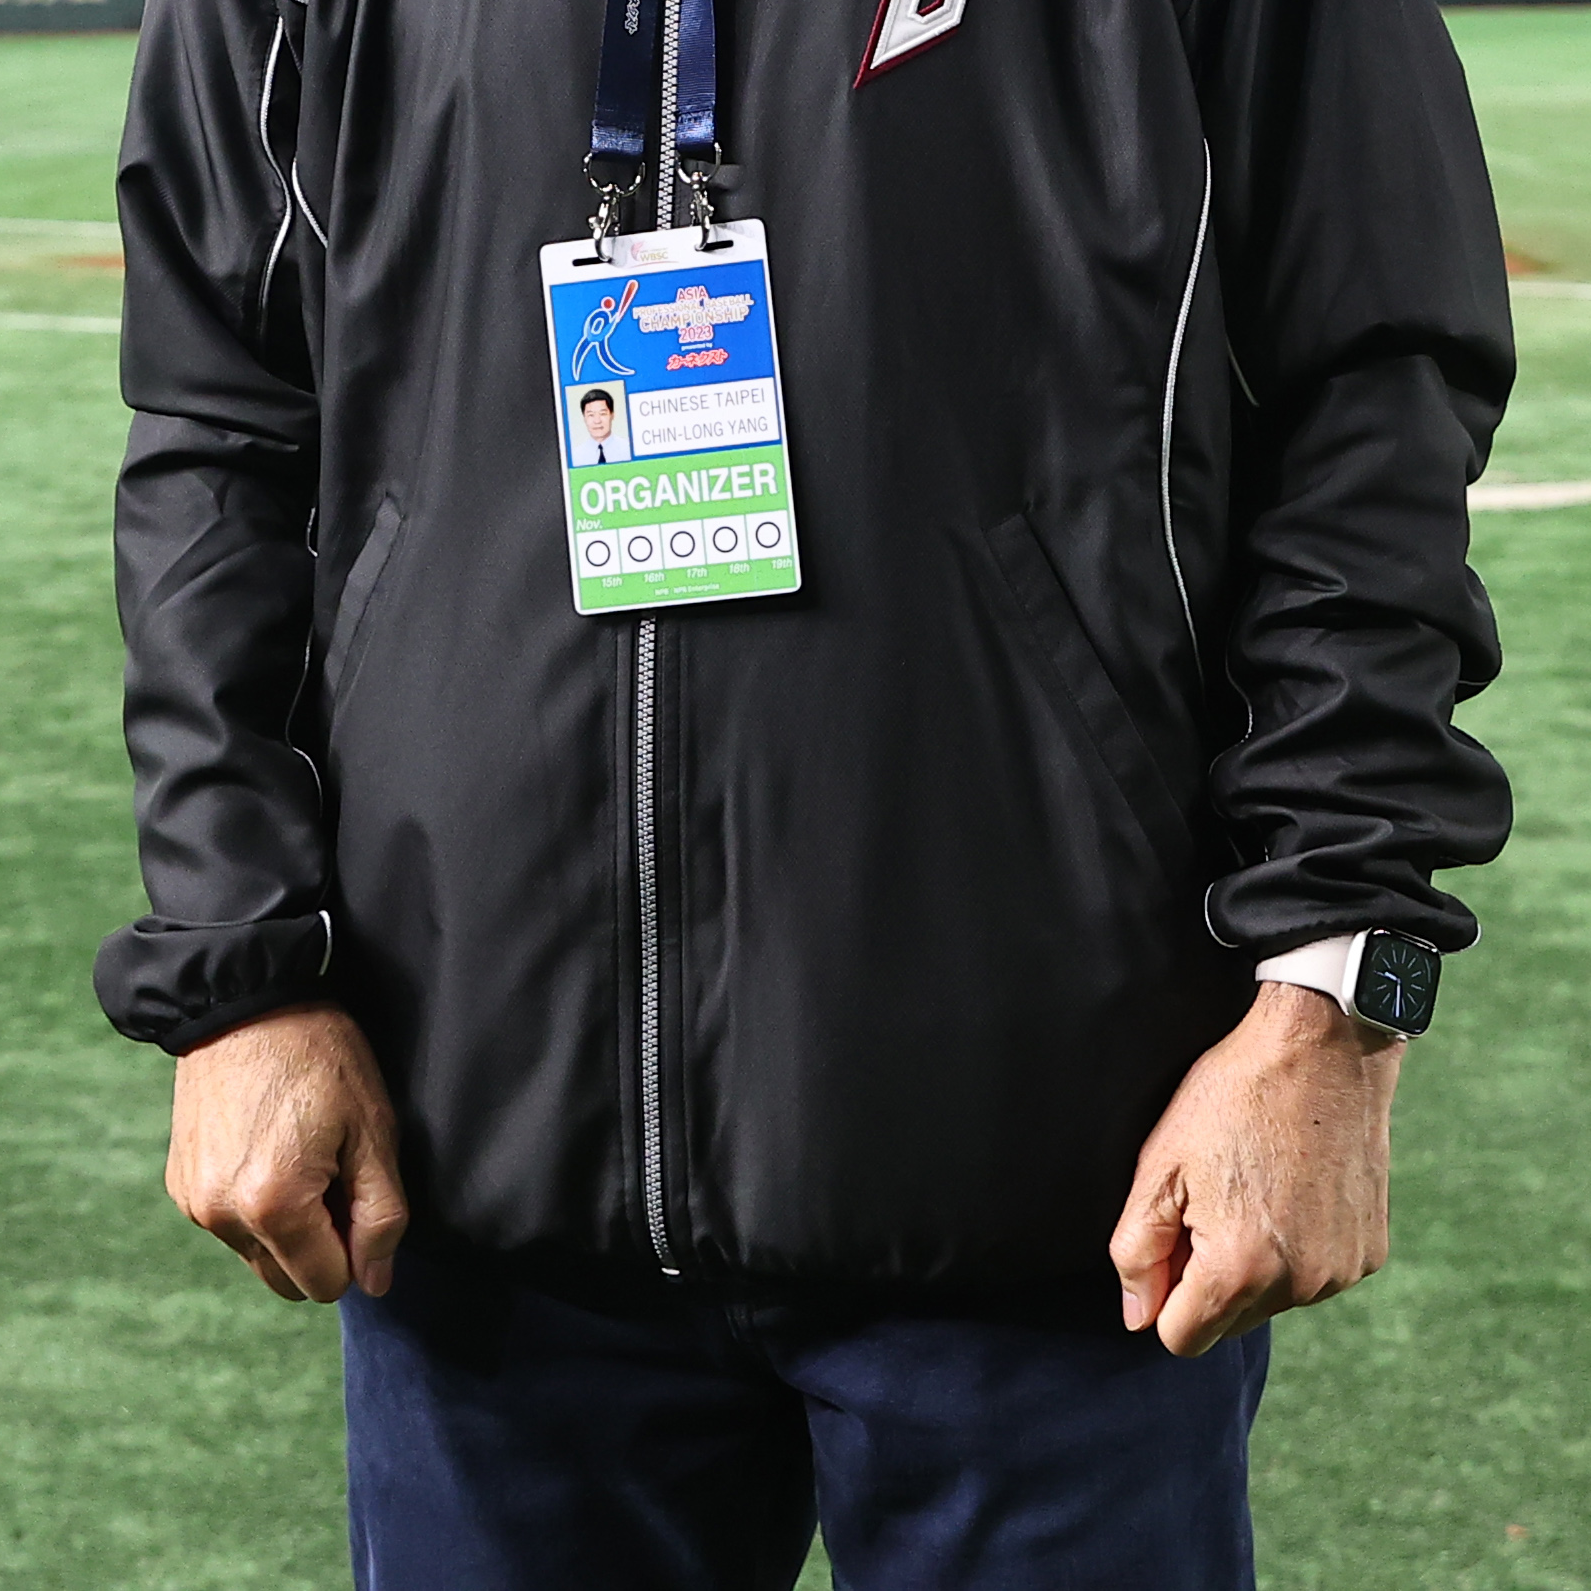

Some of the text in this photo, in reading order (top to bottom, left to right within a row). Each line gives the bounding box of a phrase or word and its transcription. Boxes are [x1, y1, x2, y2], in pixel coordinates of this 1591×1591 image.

[640, 251, 669, 262] WBSC
[677, 287, 709, 301] ASIA
[704, 294, 753, 309] BASEBALL
[640, 306, 749, 331] CHAMPIONSHIP
[679, 324, 713, 342] 2023
[639, 388, 766, 417] CHINESE TAIPEI
[641, 416, 769, 446] CHIN-LONG YANG
[579, 462, 779, 515] ORGANIZER
[576, 518, 603, 531] Nov.
[602, 558, 793, 588] 15th 16th 17th 18th 19th
